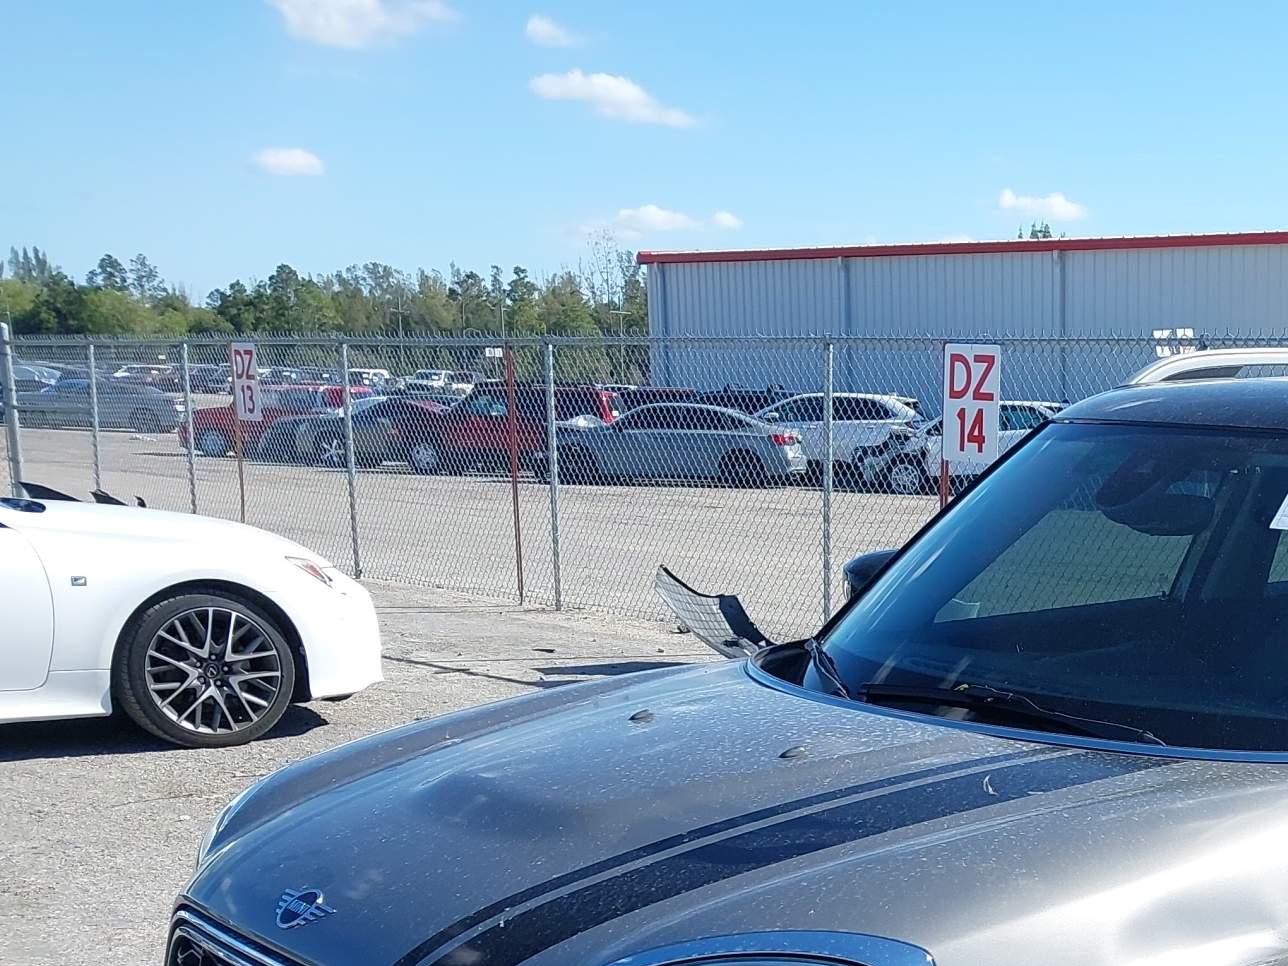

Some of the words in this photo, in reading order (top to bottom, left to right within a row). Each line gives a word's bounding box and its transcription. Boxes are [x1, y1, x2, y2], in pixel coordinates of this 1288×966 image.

[234, 349, 255, 380] DZ
[949, 353, 995, 401] DZ
[241, 385, 255, 414] 13
[956, 407, 985, 453] 14
